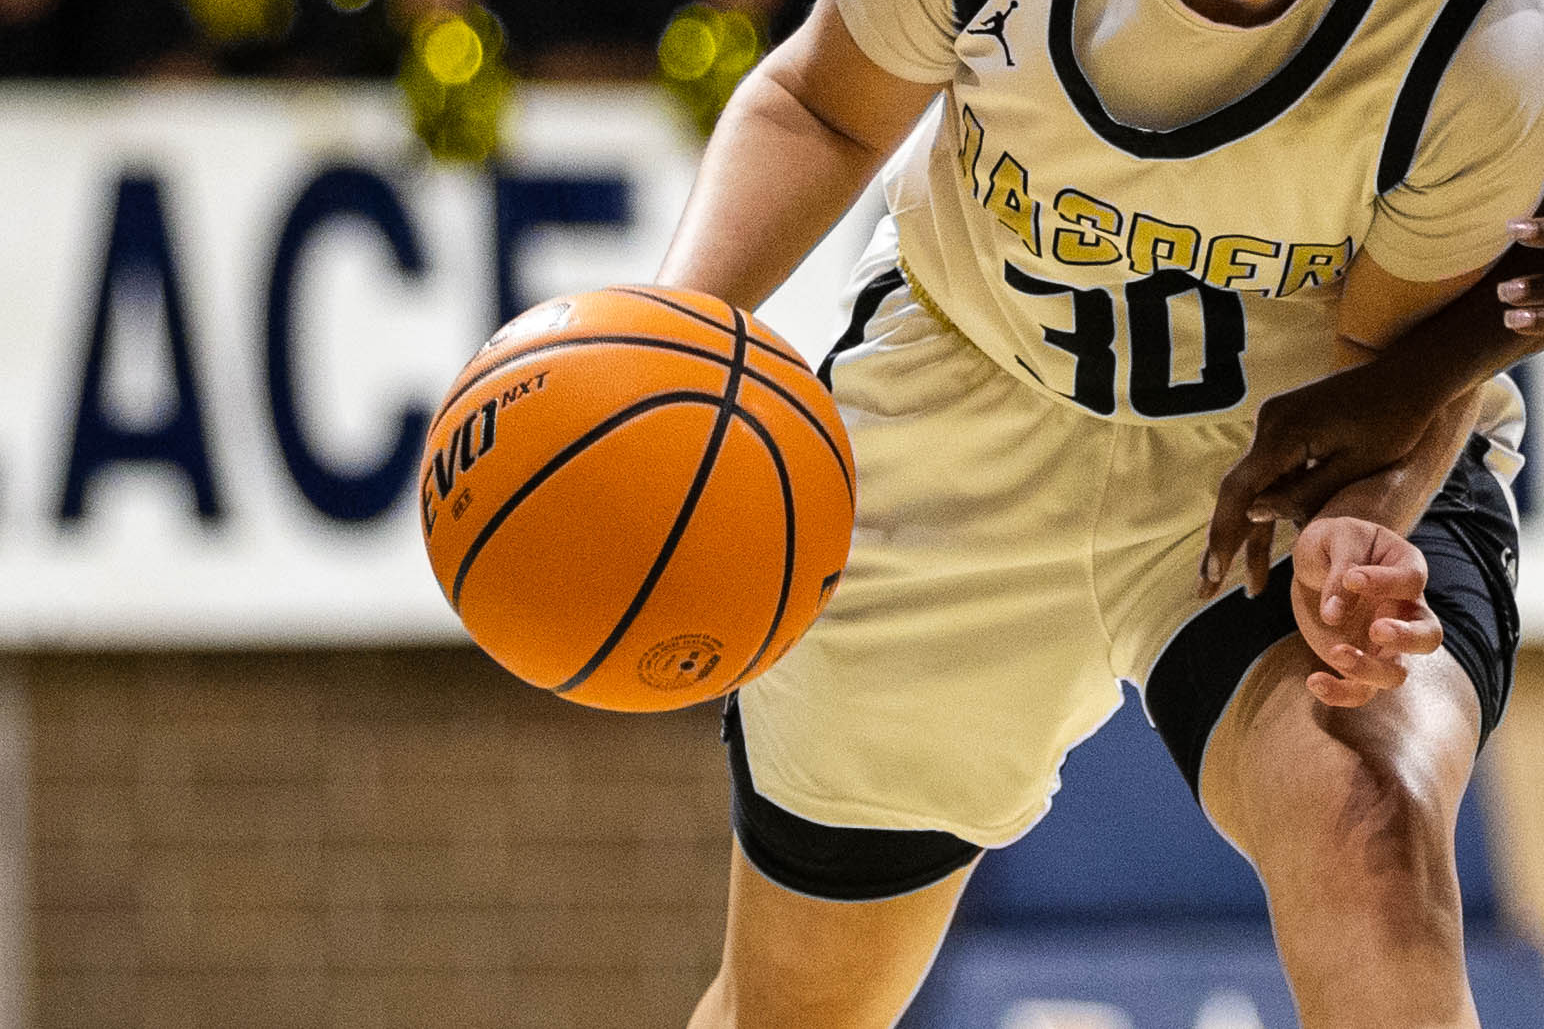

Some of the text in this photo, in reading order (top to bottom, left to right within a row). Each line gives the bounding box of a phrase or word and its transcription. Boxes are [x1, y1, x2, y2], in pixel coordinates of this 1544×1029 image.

[958, 103, 1356, 299] JASPER
[1003, 258, 1249, 418] 30
[421, 370, 551, 539] EVO NXT
